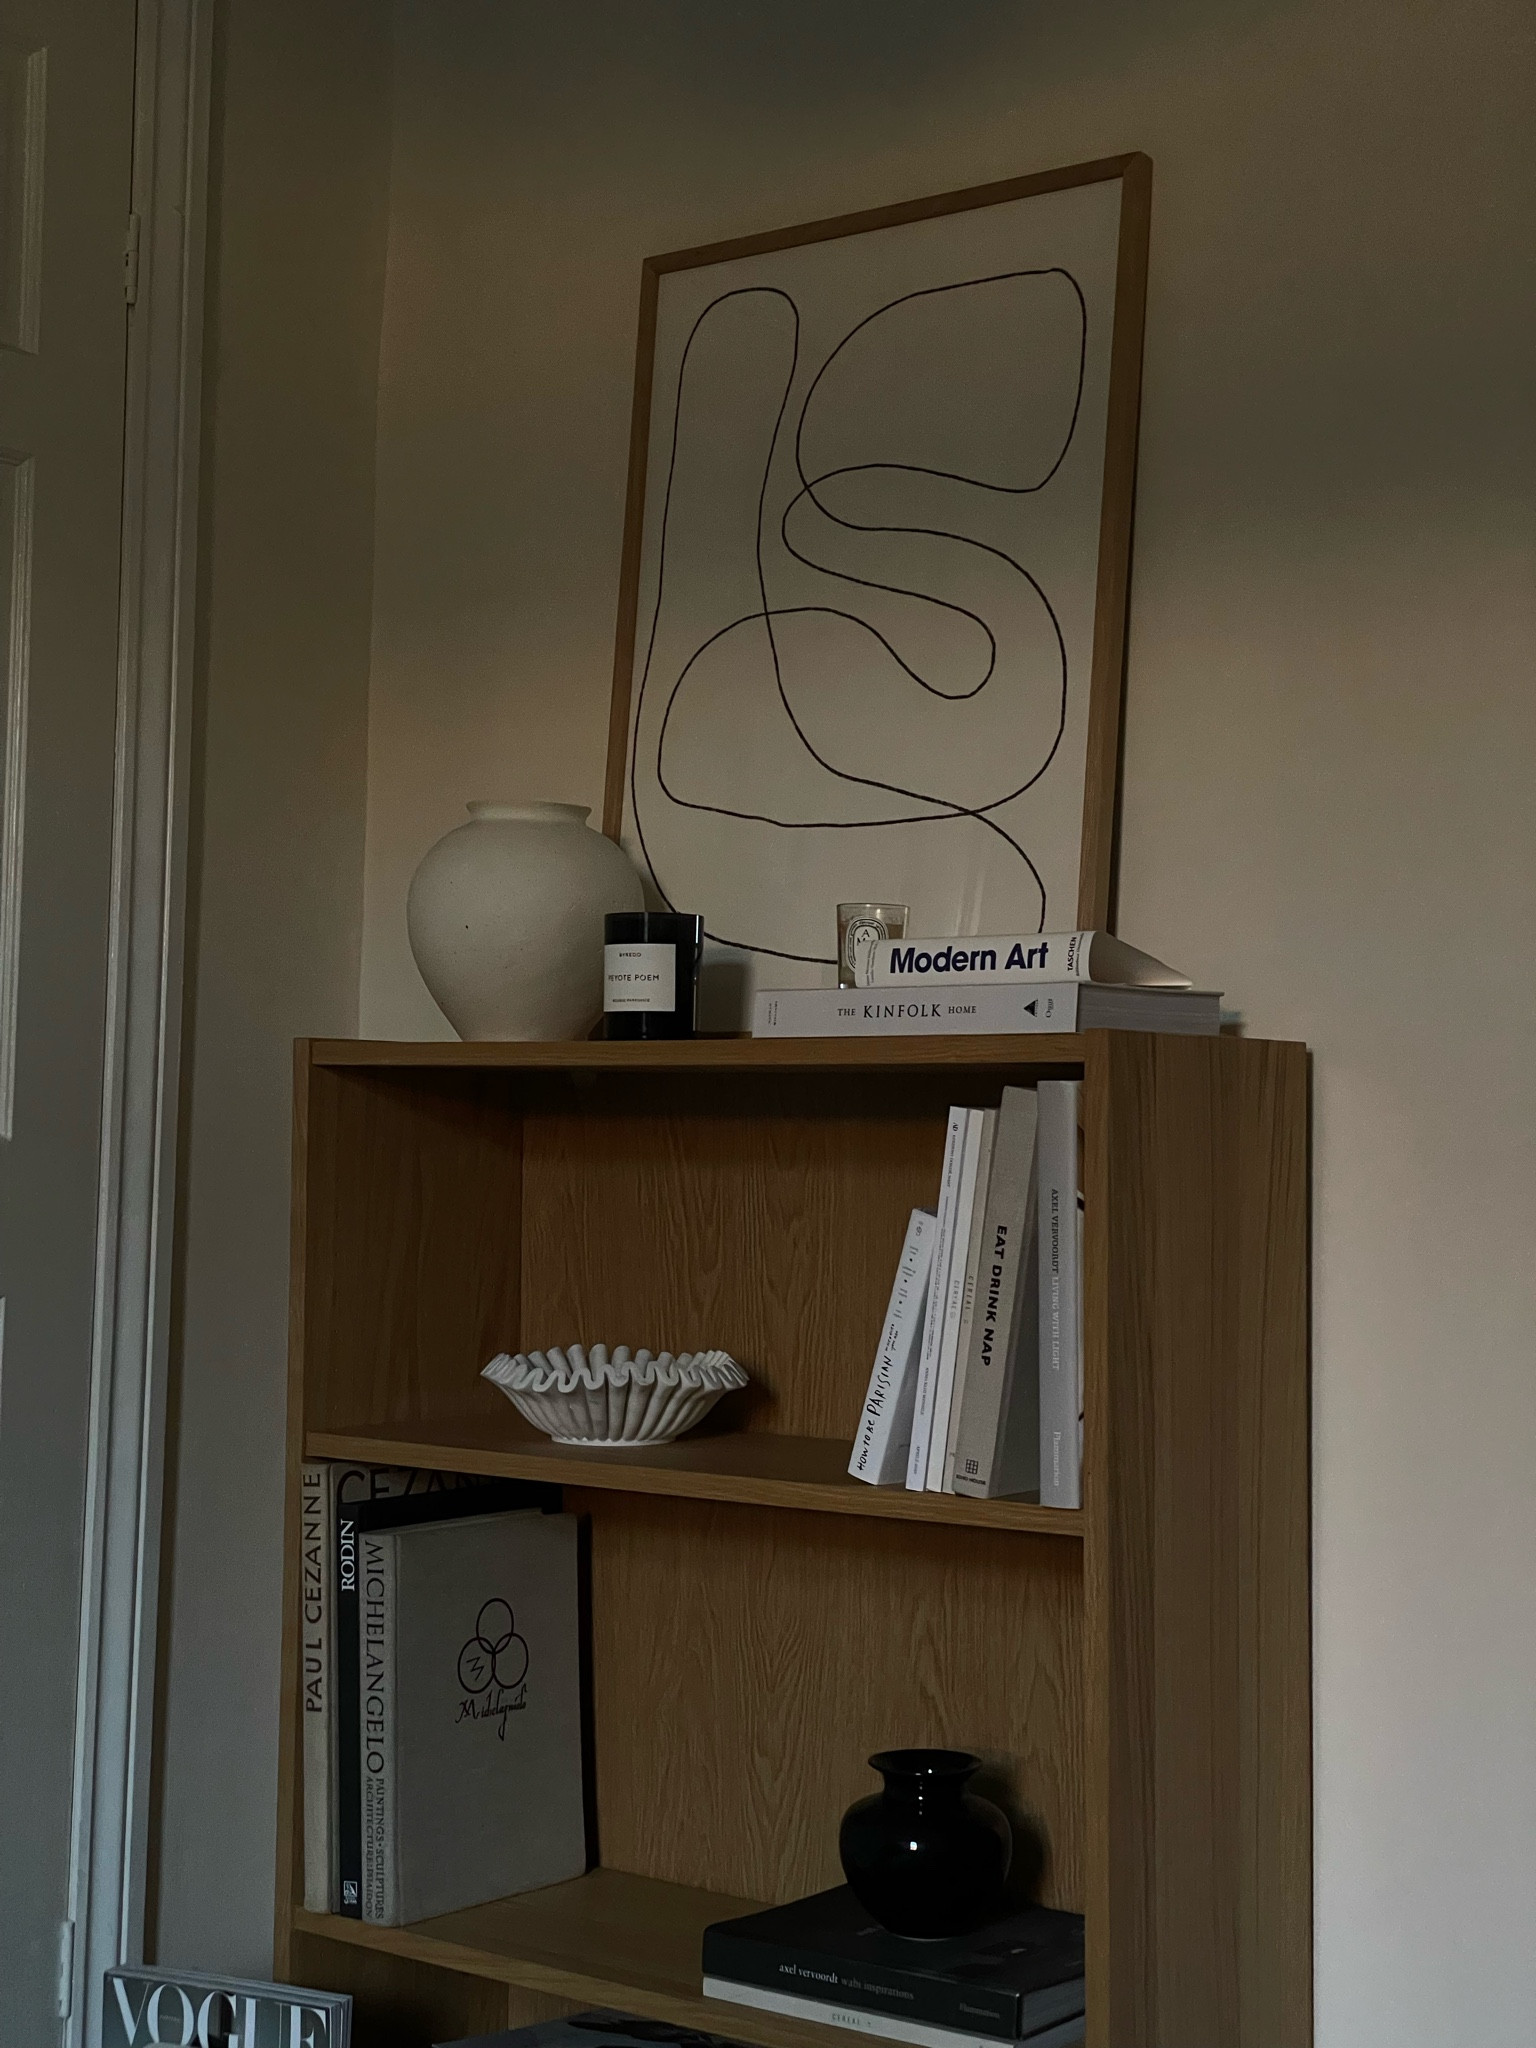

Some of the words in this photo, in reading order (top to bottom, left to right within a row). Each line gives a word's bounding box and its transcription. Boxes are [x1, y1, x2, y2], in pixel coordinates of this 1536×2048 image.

[890, 945, 997, 974] Modern
[1005, 941, 1049, 970] Art
[1067, 936, 1077, 972] TASCHEN
[634, 974, 660, 982] POEM
[838, 1008, 856, 1016] THE
[863, 1003, 942, 1018] KINFOLK
[948, 1005, 977, 1015] HOME
[1051, 1188, 1059, 1214] AXEL
[994, 1225, 1007, 1259] EAT
[1051, 1215, 1059, 1274] VERVOORDT
[985, 1264, 1002, 1323] DRINK
[1051, 1276, 1060, 1310] LIVING
[1051, 1311, 1060, 1339] WITH
[981, 1328, 995, 1366] NAP
[1051, 1341, 1060, 1371] LIGHT
[857, 1448, 869, 1471] HOW
[866, 1355, 893, 1417] PARISIAN
[303, 1473, 321, 1624] CEZANNE
[341, 1518, 355, 1592] RODIN
[305, 1637, 322, 1713] PAUL
[365, 1540, 384, 1774] MICHELANGELO
[375, 1778, 384, 1842] PAINTINGS
[375, 1848, 384, 1919] SCULPTURES
[778, 1964, 797, 1975] axel
[798, 1968, 839, 1984] vervoordt
[841, 1976, 862, 1989] wabi
[863, 1982, 915, 2001] inspirations
[107, 1977, 329, 2048] VOGUE
